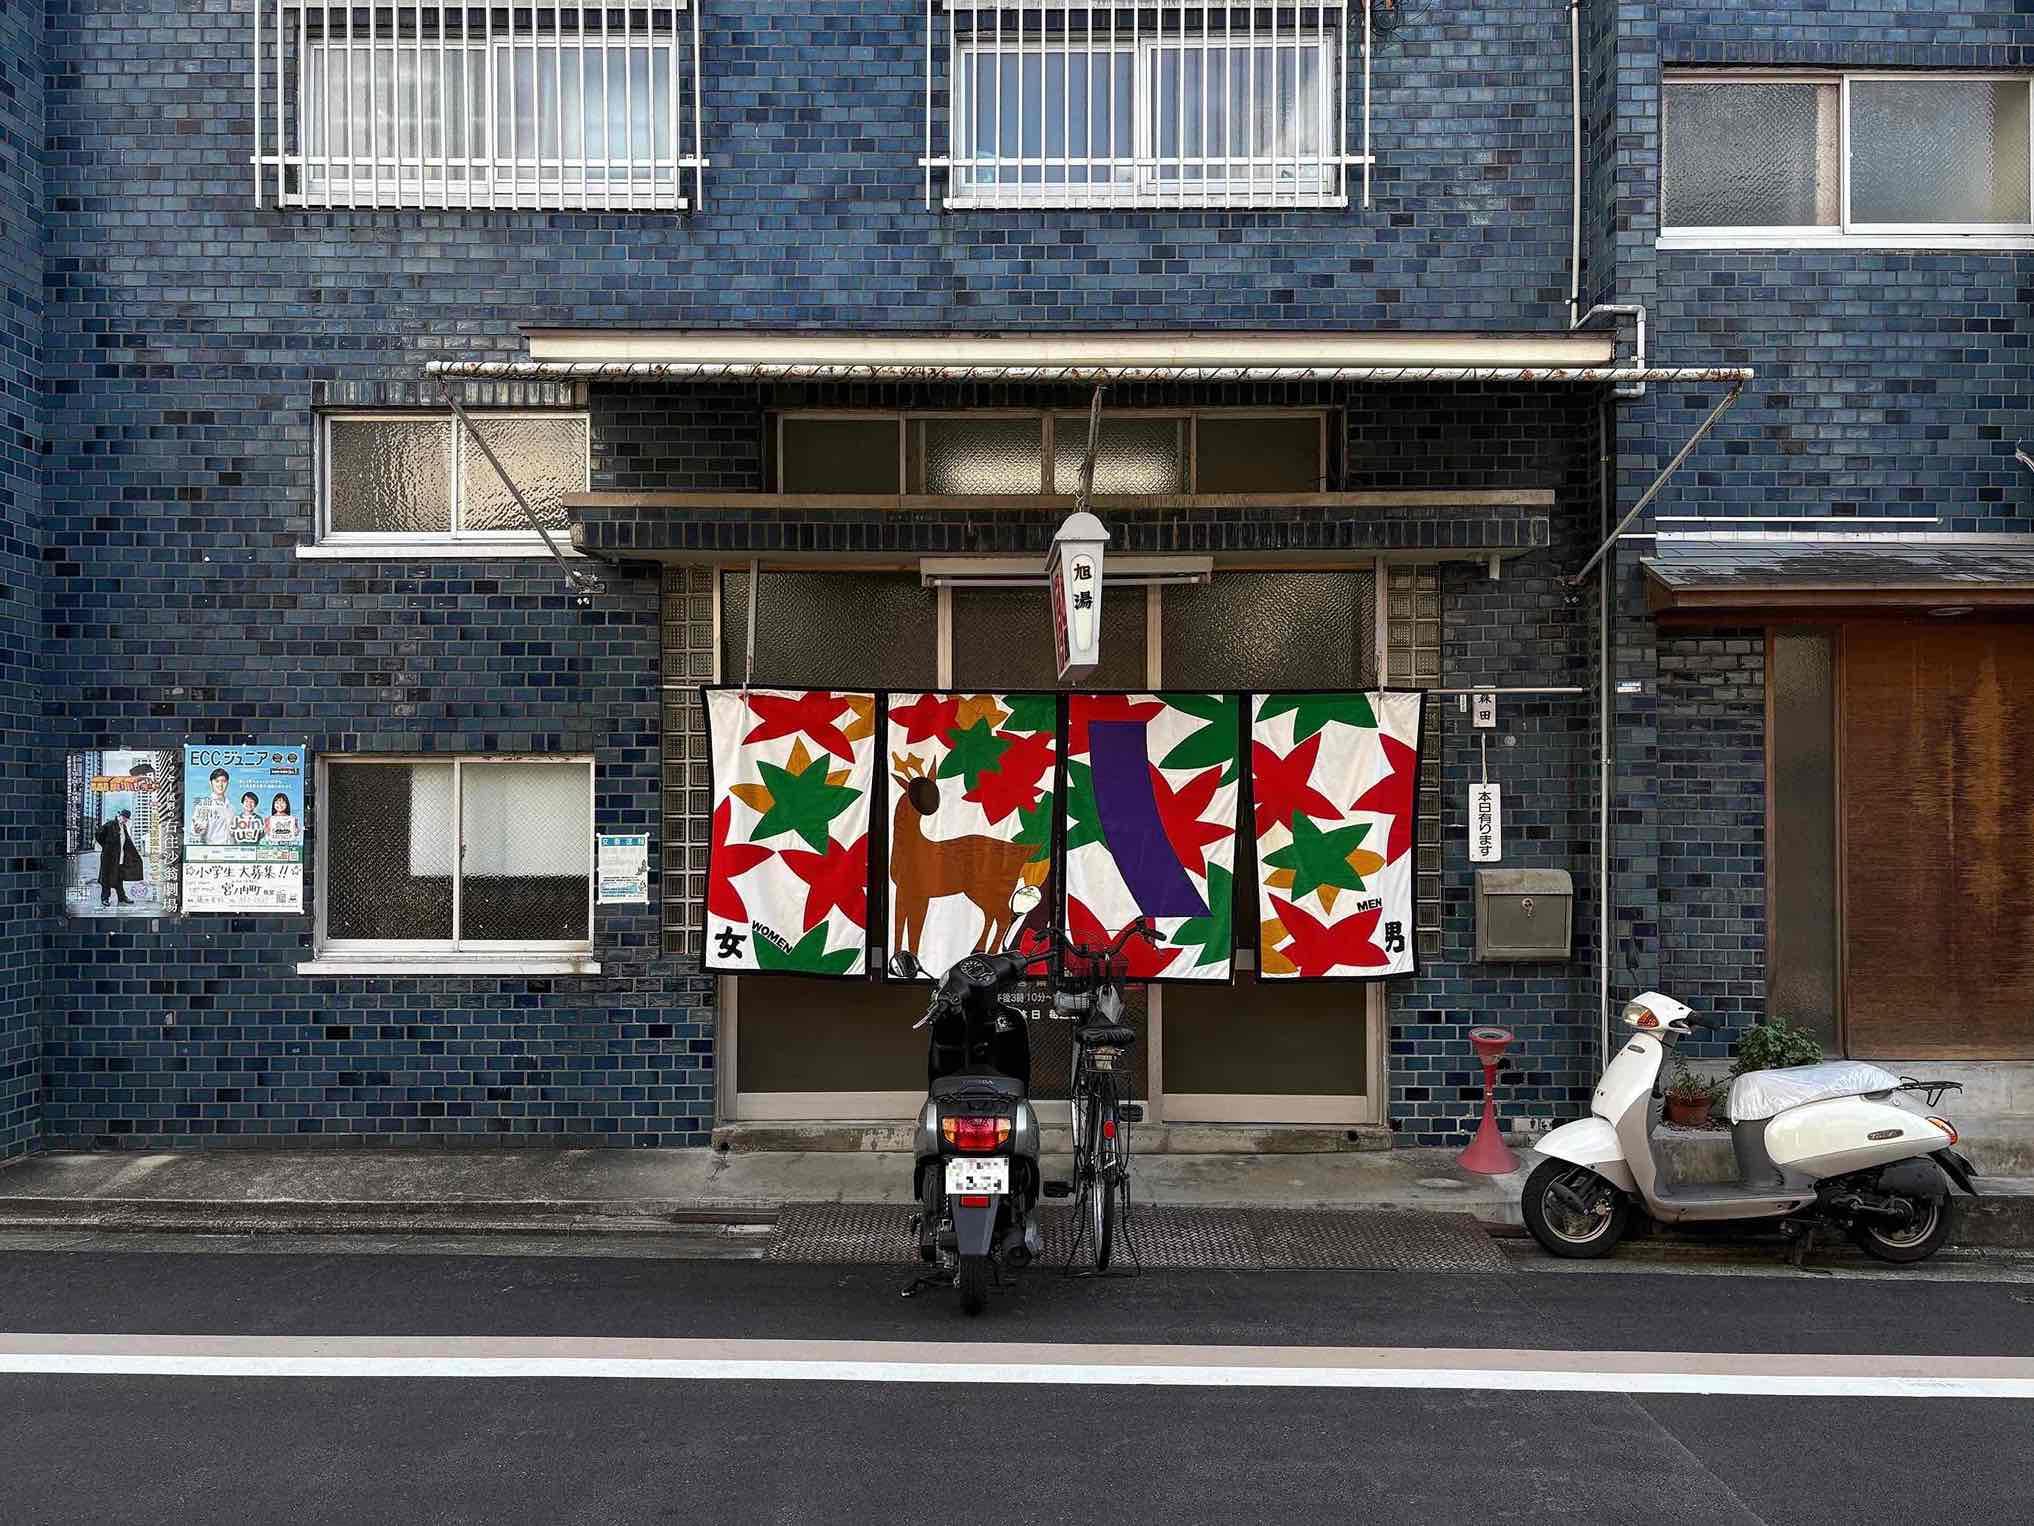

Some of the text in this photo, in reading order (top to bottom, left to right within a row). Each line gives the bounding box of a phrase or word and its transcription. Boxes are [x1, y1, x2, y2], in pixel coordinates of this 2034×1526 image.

[1073, 563, 1093, 610] 旭湯
[190, 751, 269, 768] ECCジュニア
[230, 817, 260, 830] Join
[1477, 791, 1492, 857] 本日有ります
[1356, 896, 1383, 913] MEN
[713, 925, 748, 959] 女
[751, 919, 793, 954] WOMEN
[1384, 920, 1406, 953] 男
